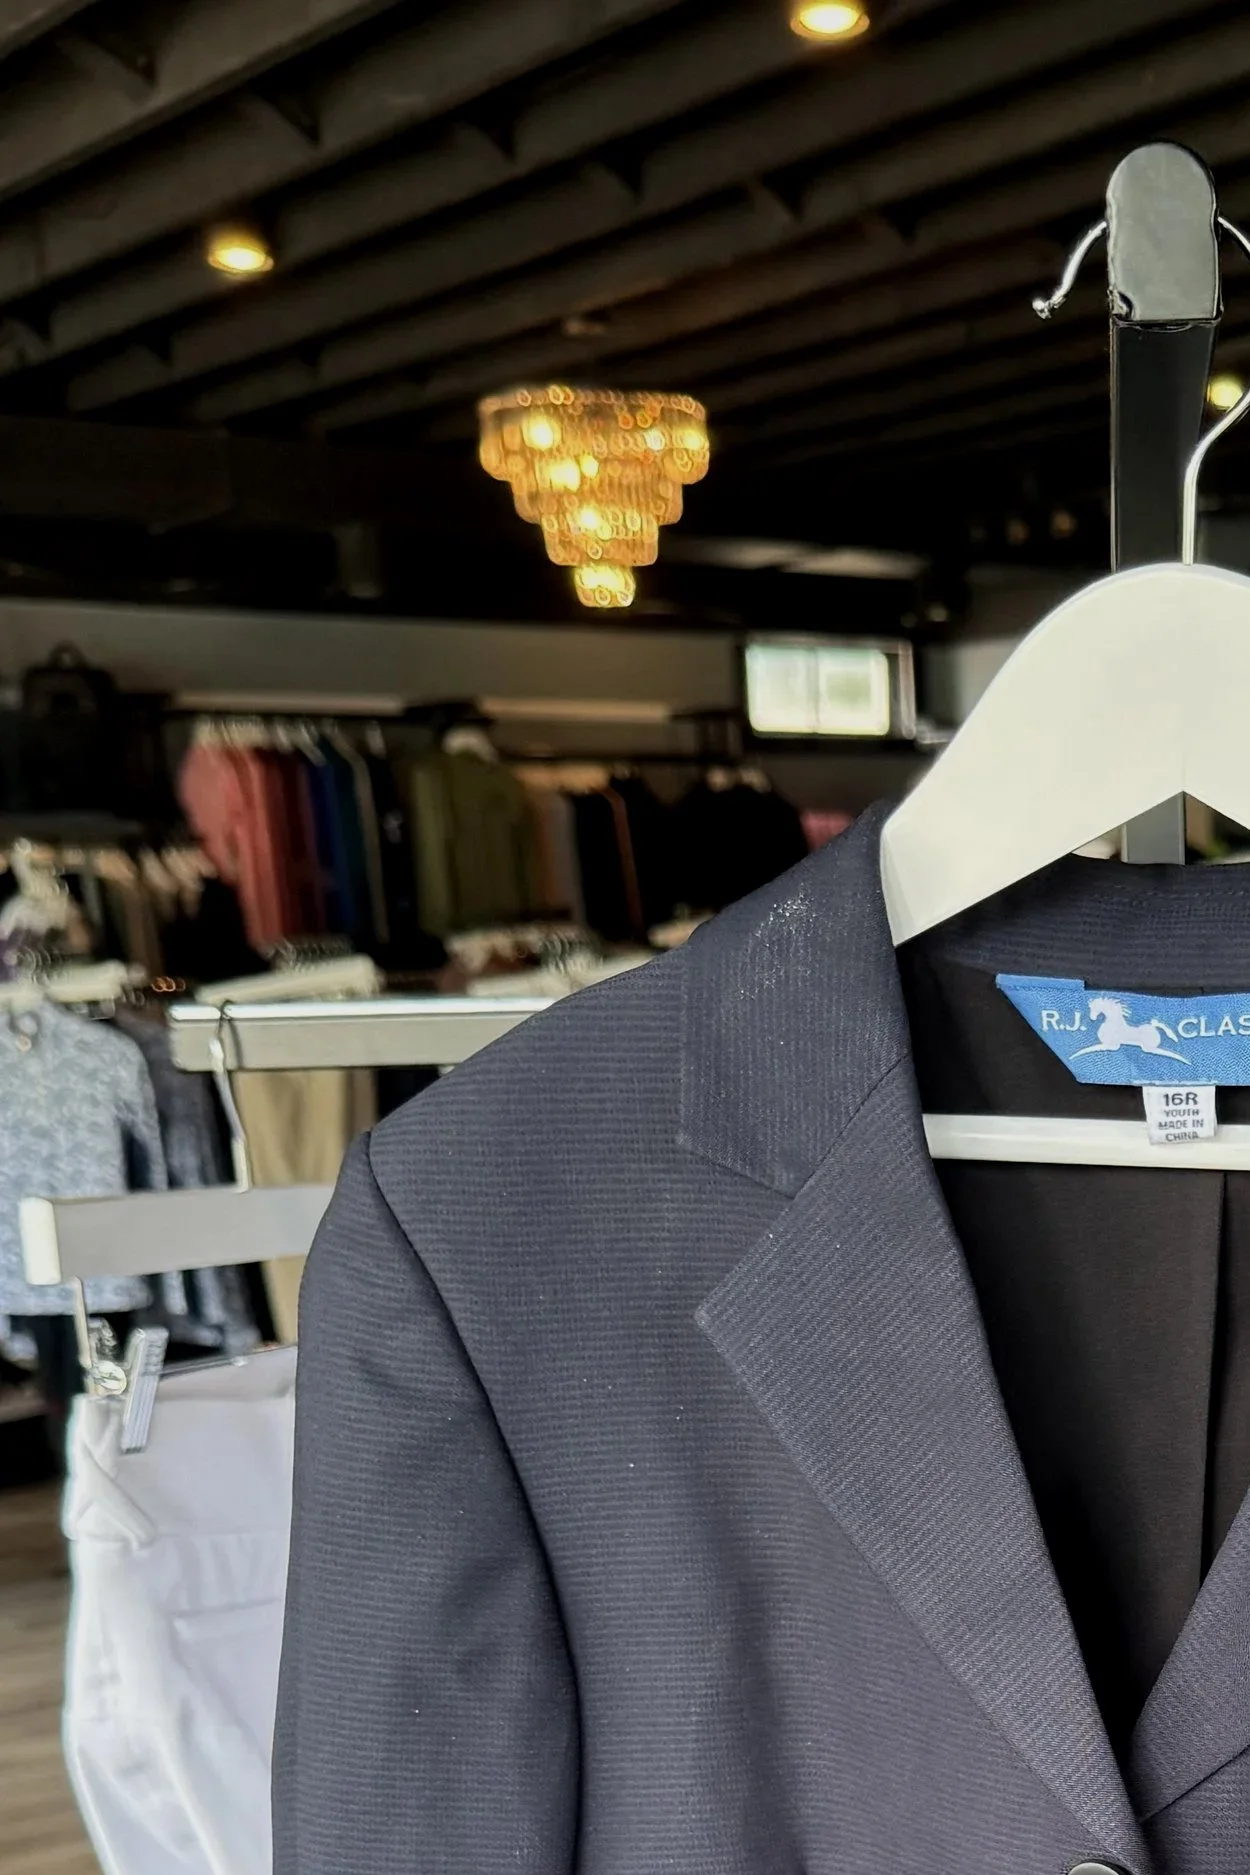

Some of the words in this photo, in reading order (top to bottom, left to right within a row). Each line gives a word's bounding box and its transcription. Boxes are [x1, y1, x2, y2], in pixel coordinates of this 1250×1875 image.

[1040, 1009, 1087, 1032] R.J.
[1163, 1091, 1199, 1107] 16R
[1163, 1108, 1200, 1118] YOUTH
[1158, 1119, 1189, 1130] MADE
[1191, 1118, 1205, 1129] IN
[1165, 1131, 1200, 1142] CHINA
